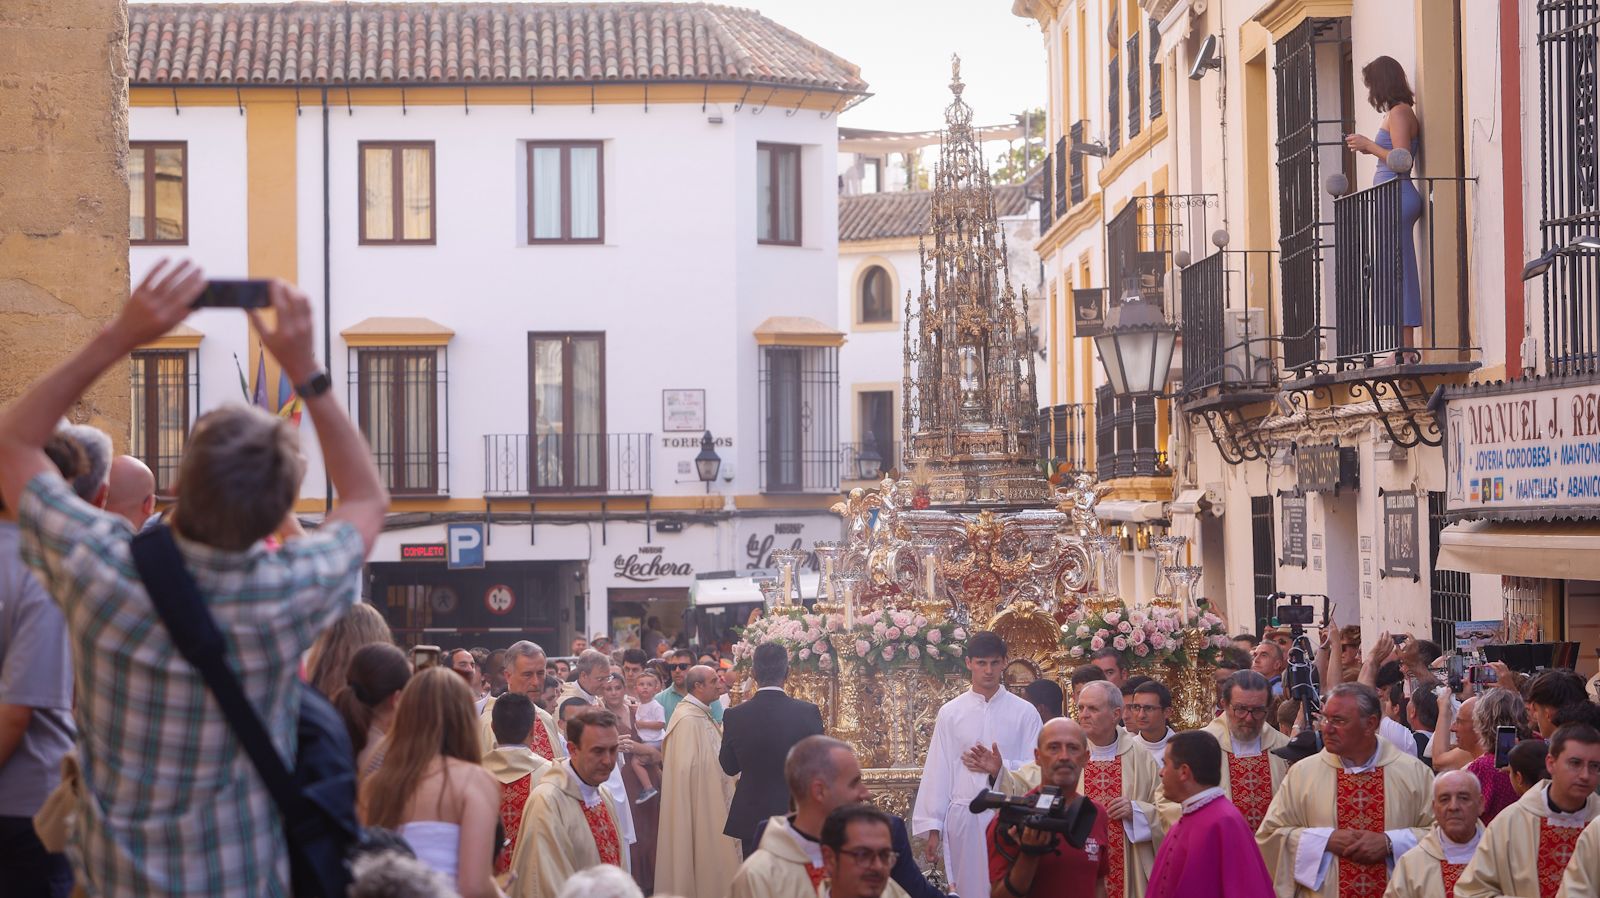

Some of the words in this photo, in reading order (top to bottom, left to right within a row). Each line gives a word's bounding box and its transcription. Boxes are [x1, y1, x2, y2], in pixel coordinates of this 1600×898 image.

[1468, 400, 1541, 445] MANUEL
[1548, 397, 1563, 439] J.
[662, 437, 733, 447] TORROS
[1475, 449, 1503, 471] JOYERIA
[1506, 446, 1550, 469] CORDOBESA
[1516, 477, 1557, 499] MANTILLAS
[403, 546, 444, 557] COMPLETO
[451, 527, 481, 563] P
[614, 554, 691, 582] Lechera
